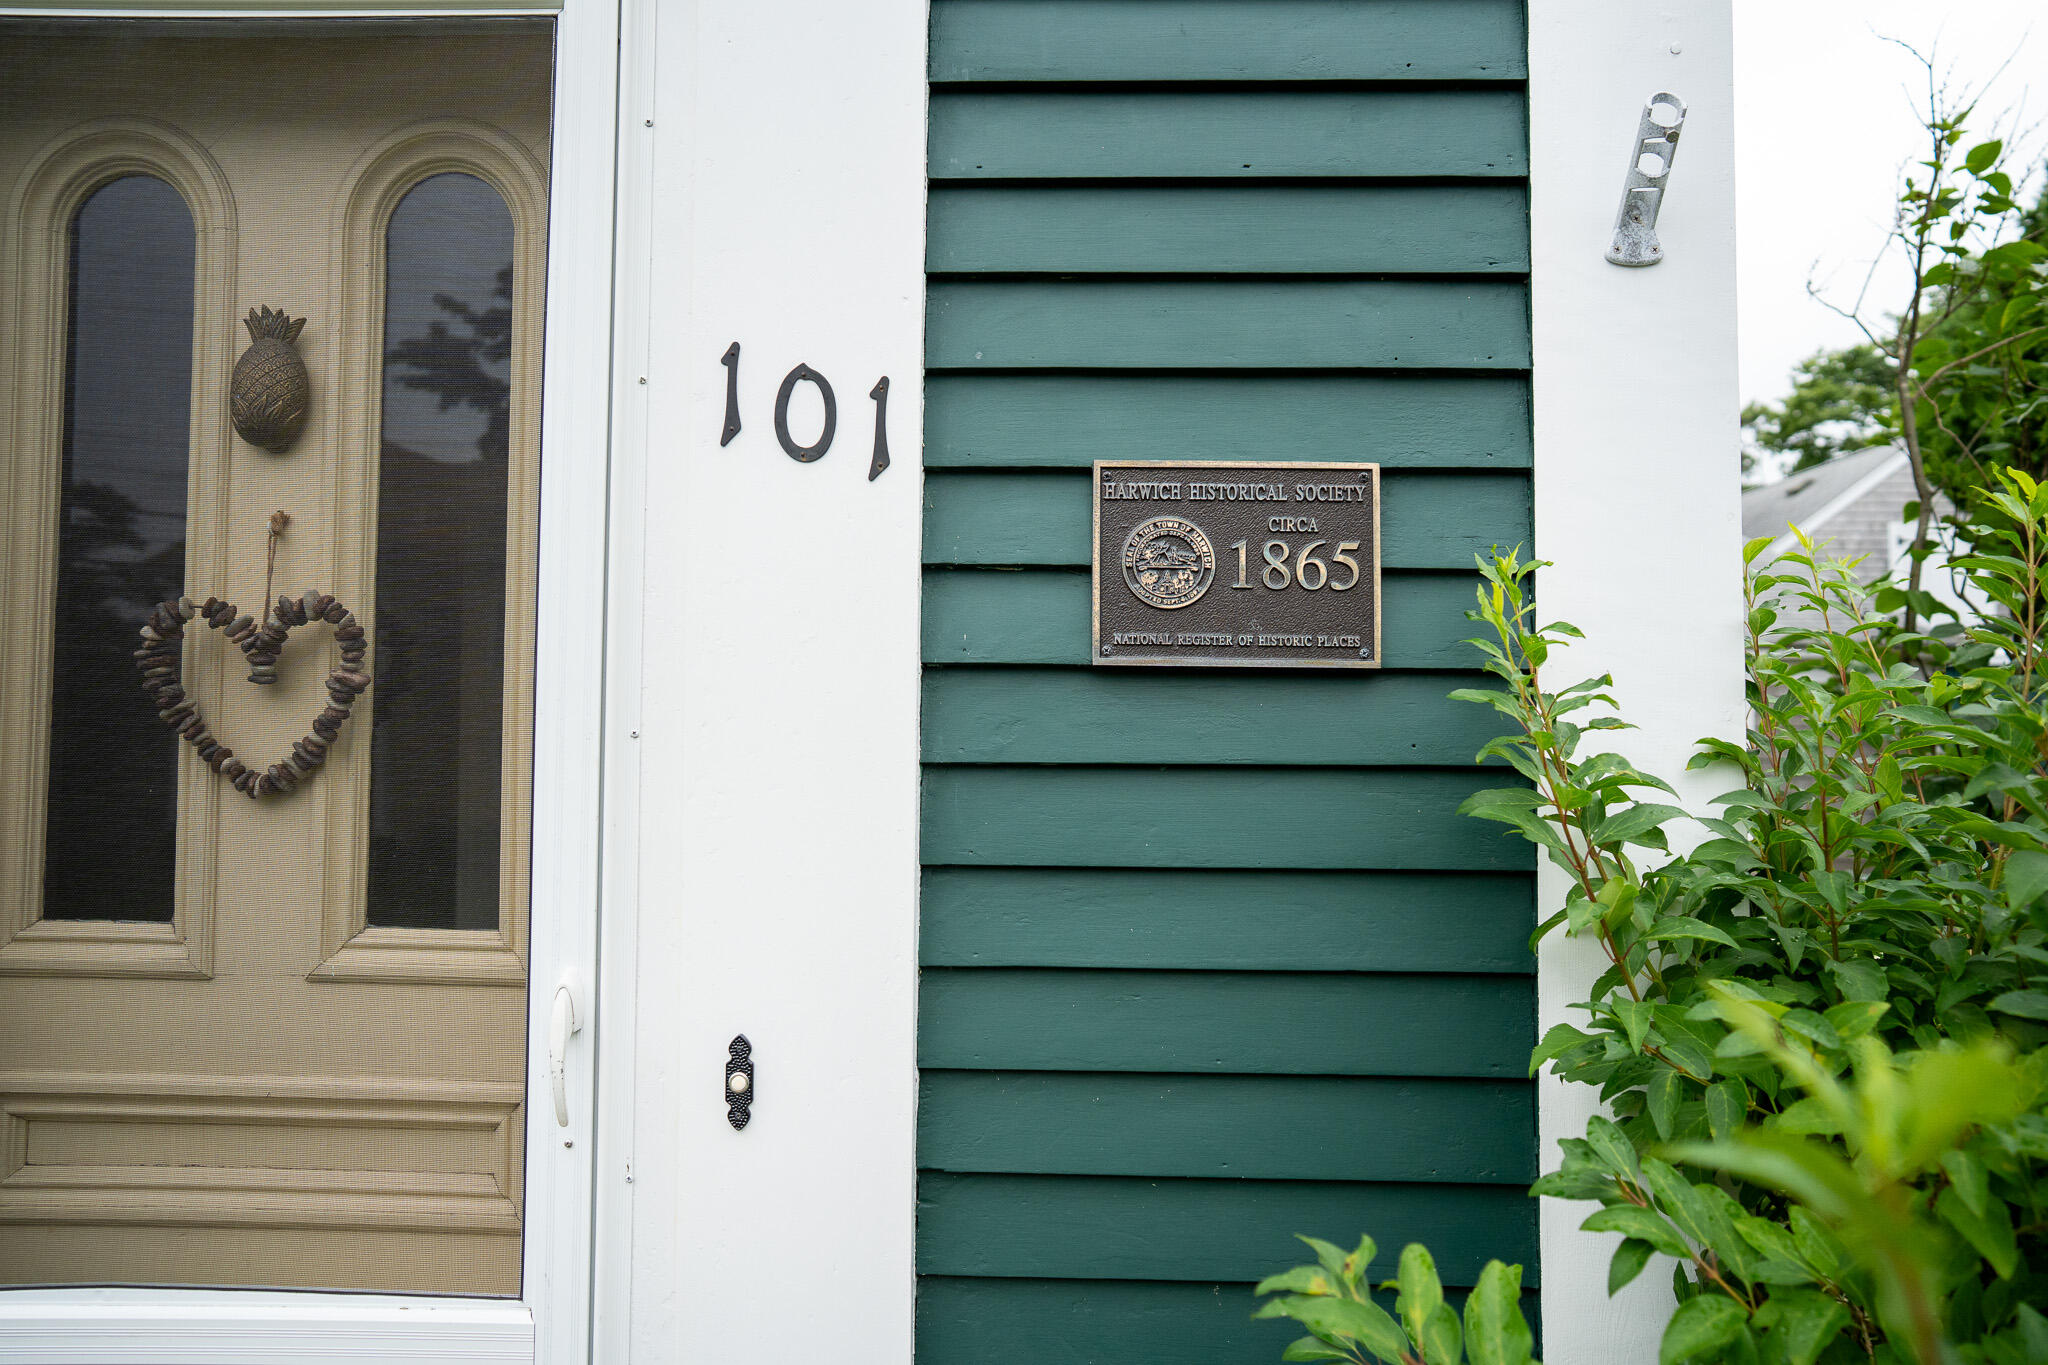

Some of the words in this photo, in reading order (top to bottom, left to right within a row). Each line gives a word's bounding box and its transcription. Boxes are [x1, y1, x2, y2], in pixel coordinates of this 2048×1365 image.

[720, 341, 890, 482] 101
[1103, 483, 1181, 501] HARWICH
[1189, 484, 1287, 502] HISTORICAL
[1295, 484, 1367, 503] SOCIETY
[1268, 516, 1319, 533] CIRCA
[1131, 534, 1141, 547] OF
[1139, 524, 1155, 537] THE
[1155, 521, 1179, 529] TOWN
[1180, 523, 1192, 533] OF
[1192, 531, 1212, 569] HARWICH
[1230, 539, 1361, 591] 1865
[1113, 633, 1173, 647] NATIONAL
[1177, 633, 1233, 647] REGISTER
[1238, 634, 1253, 647] OF
[1258, 634, 1313, 647] HISTORIC
[1317, 635, 1361, 648] PLACES
